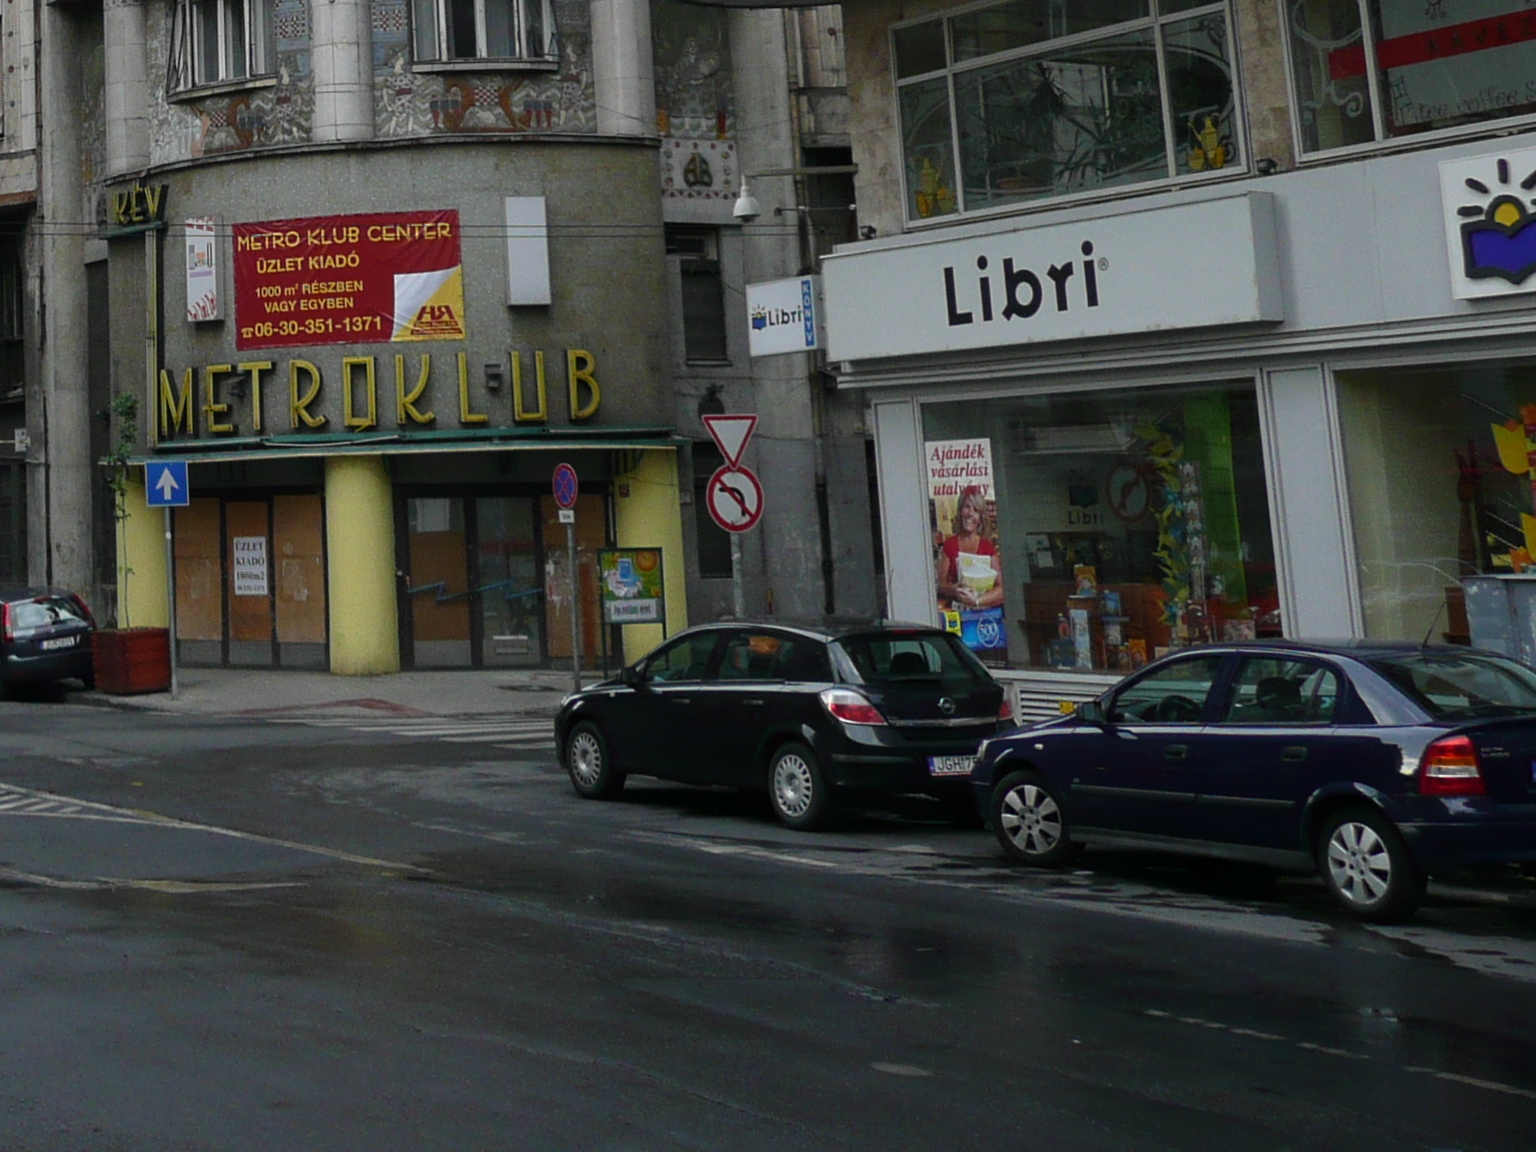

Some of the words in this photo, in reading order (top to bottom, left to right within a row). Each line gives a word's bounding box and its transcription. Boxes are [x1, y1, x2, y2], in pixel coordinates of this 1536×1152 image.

[237, 230, 301, 252] METRO
[307, 226, 360, 246] KLUB
[367, 222, 452, 242] CENTER
[256, 257, 305, 274] ÜZLET
[308, 250, 360, 269] KIADÓ
[255, 285, 282, 298] 1000
[302, 279, 364, 295] RÉSZBEN
[943, 240, 1099, 327] Libri
[263, 300, 297, 314] VAGY
[300, 297, 354, 311] EGYBEN
[768, 304, 802, 326] Libri
[254, 316, 383, 338] 06-30-351-1371
[930, 443, 986, 466] Ajándék
[930, 461, 989, 479] vásárlási
